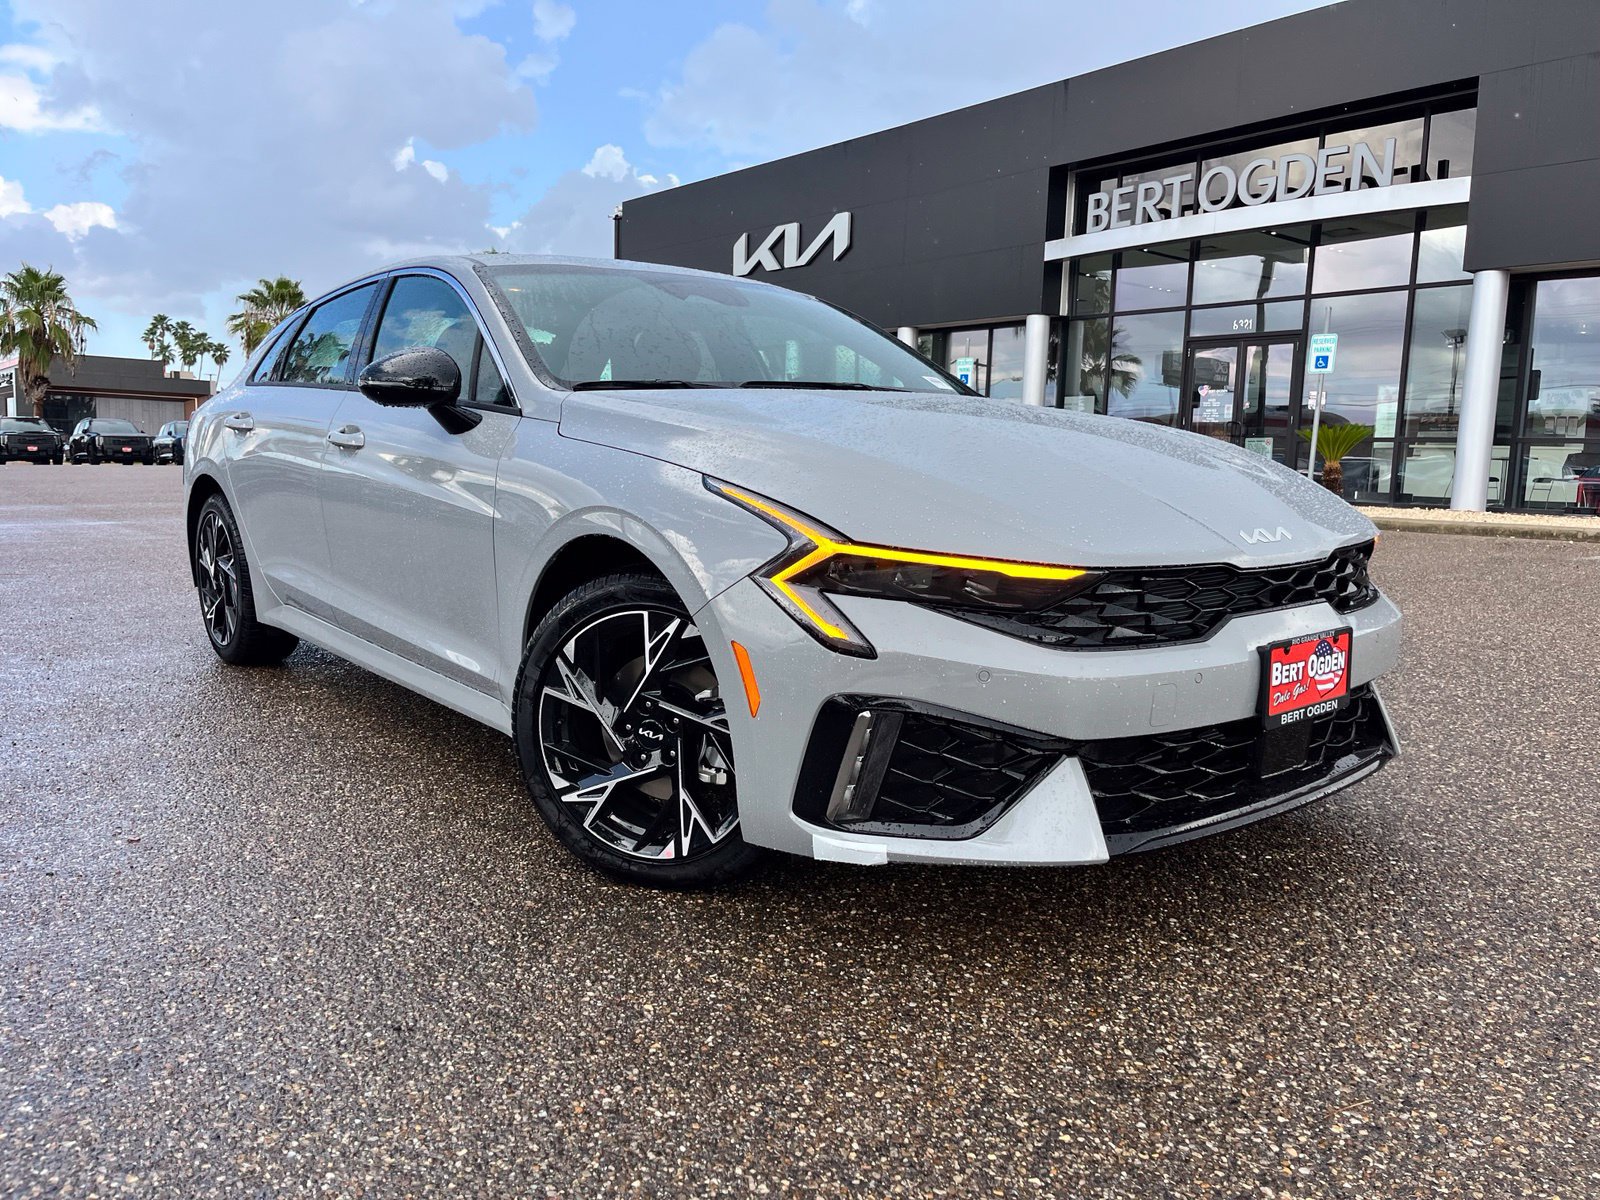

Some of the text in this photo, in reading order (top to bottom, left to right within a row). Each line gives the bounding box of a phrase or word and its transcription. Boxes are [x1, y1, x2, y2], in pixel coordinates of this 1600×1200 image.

[1086, 137, 1397, 234] BERT OGDEN
[733, 211, 851, 277] KIA
[1240, 526, 1292, 545] KIA
[1271, 651, 1346, 687] BERT OGDEN
[1273, 690, 1291, 706] Dale
[1281, 699, 1338, 725] BERT OGDEN
